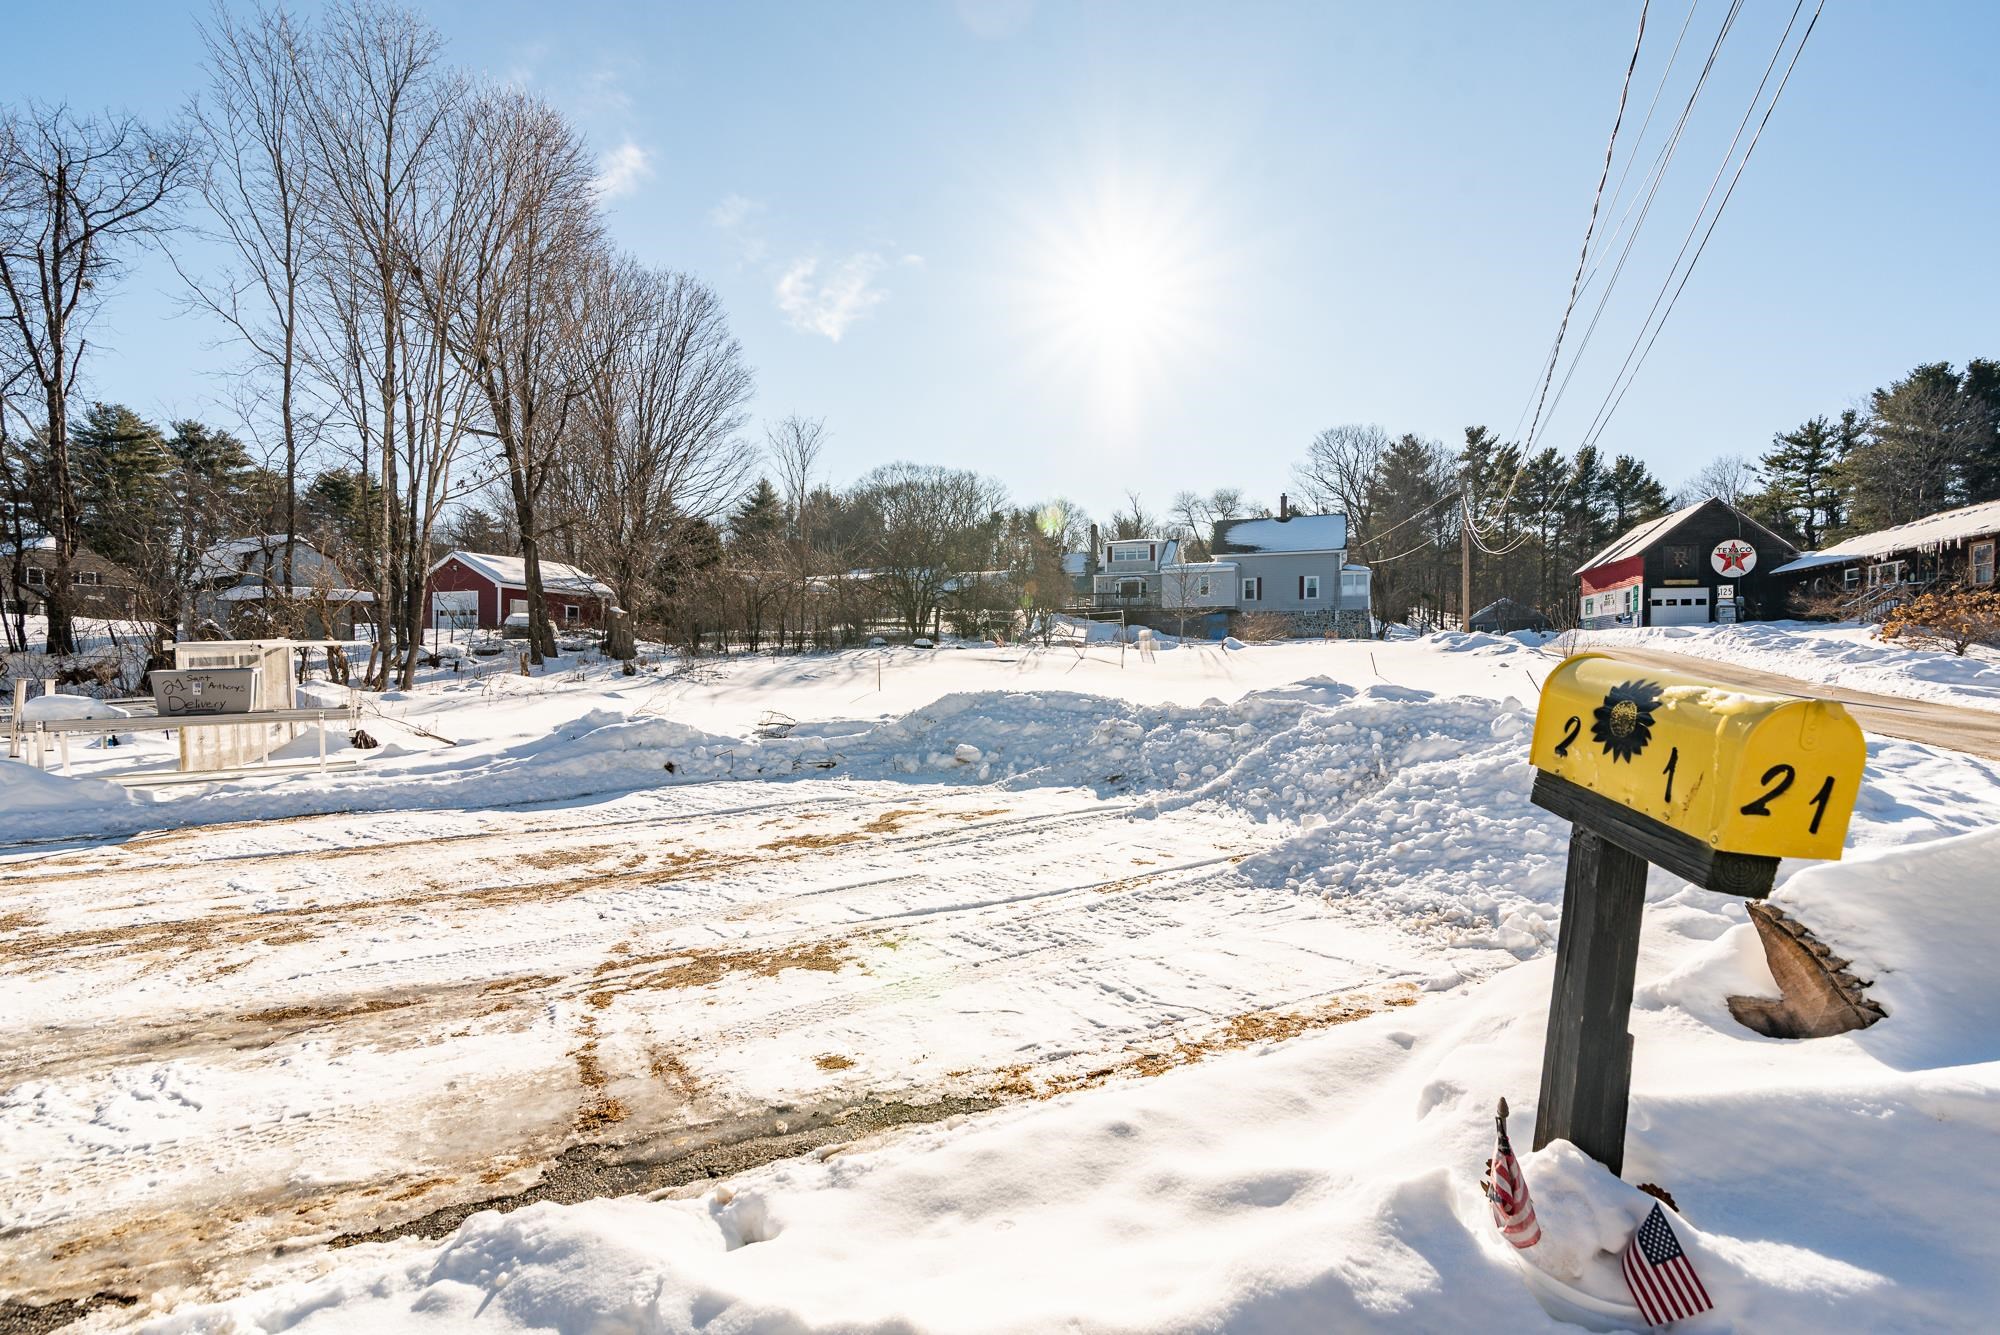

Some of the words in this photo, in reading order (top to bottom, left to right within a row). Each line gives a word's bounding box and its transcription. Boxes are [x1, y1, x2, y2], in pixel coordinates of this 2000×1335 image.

[1720, 588, 1733, 596] 125
[162, 678, 188, 695] 21
[168, 696, 227, 711] Delivery
[1740, 764, 1835, 834] 21
